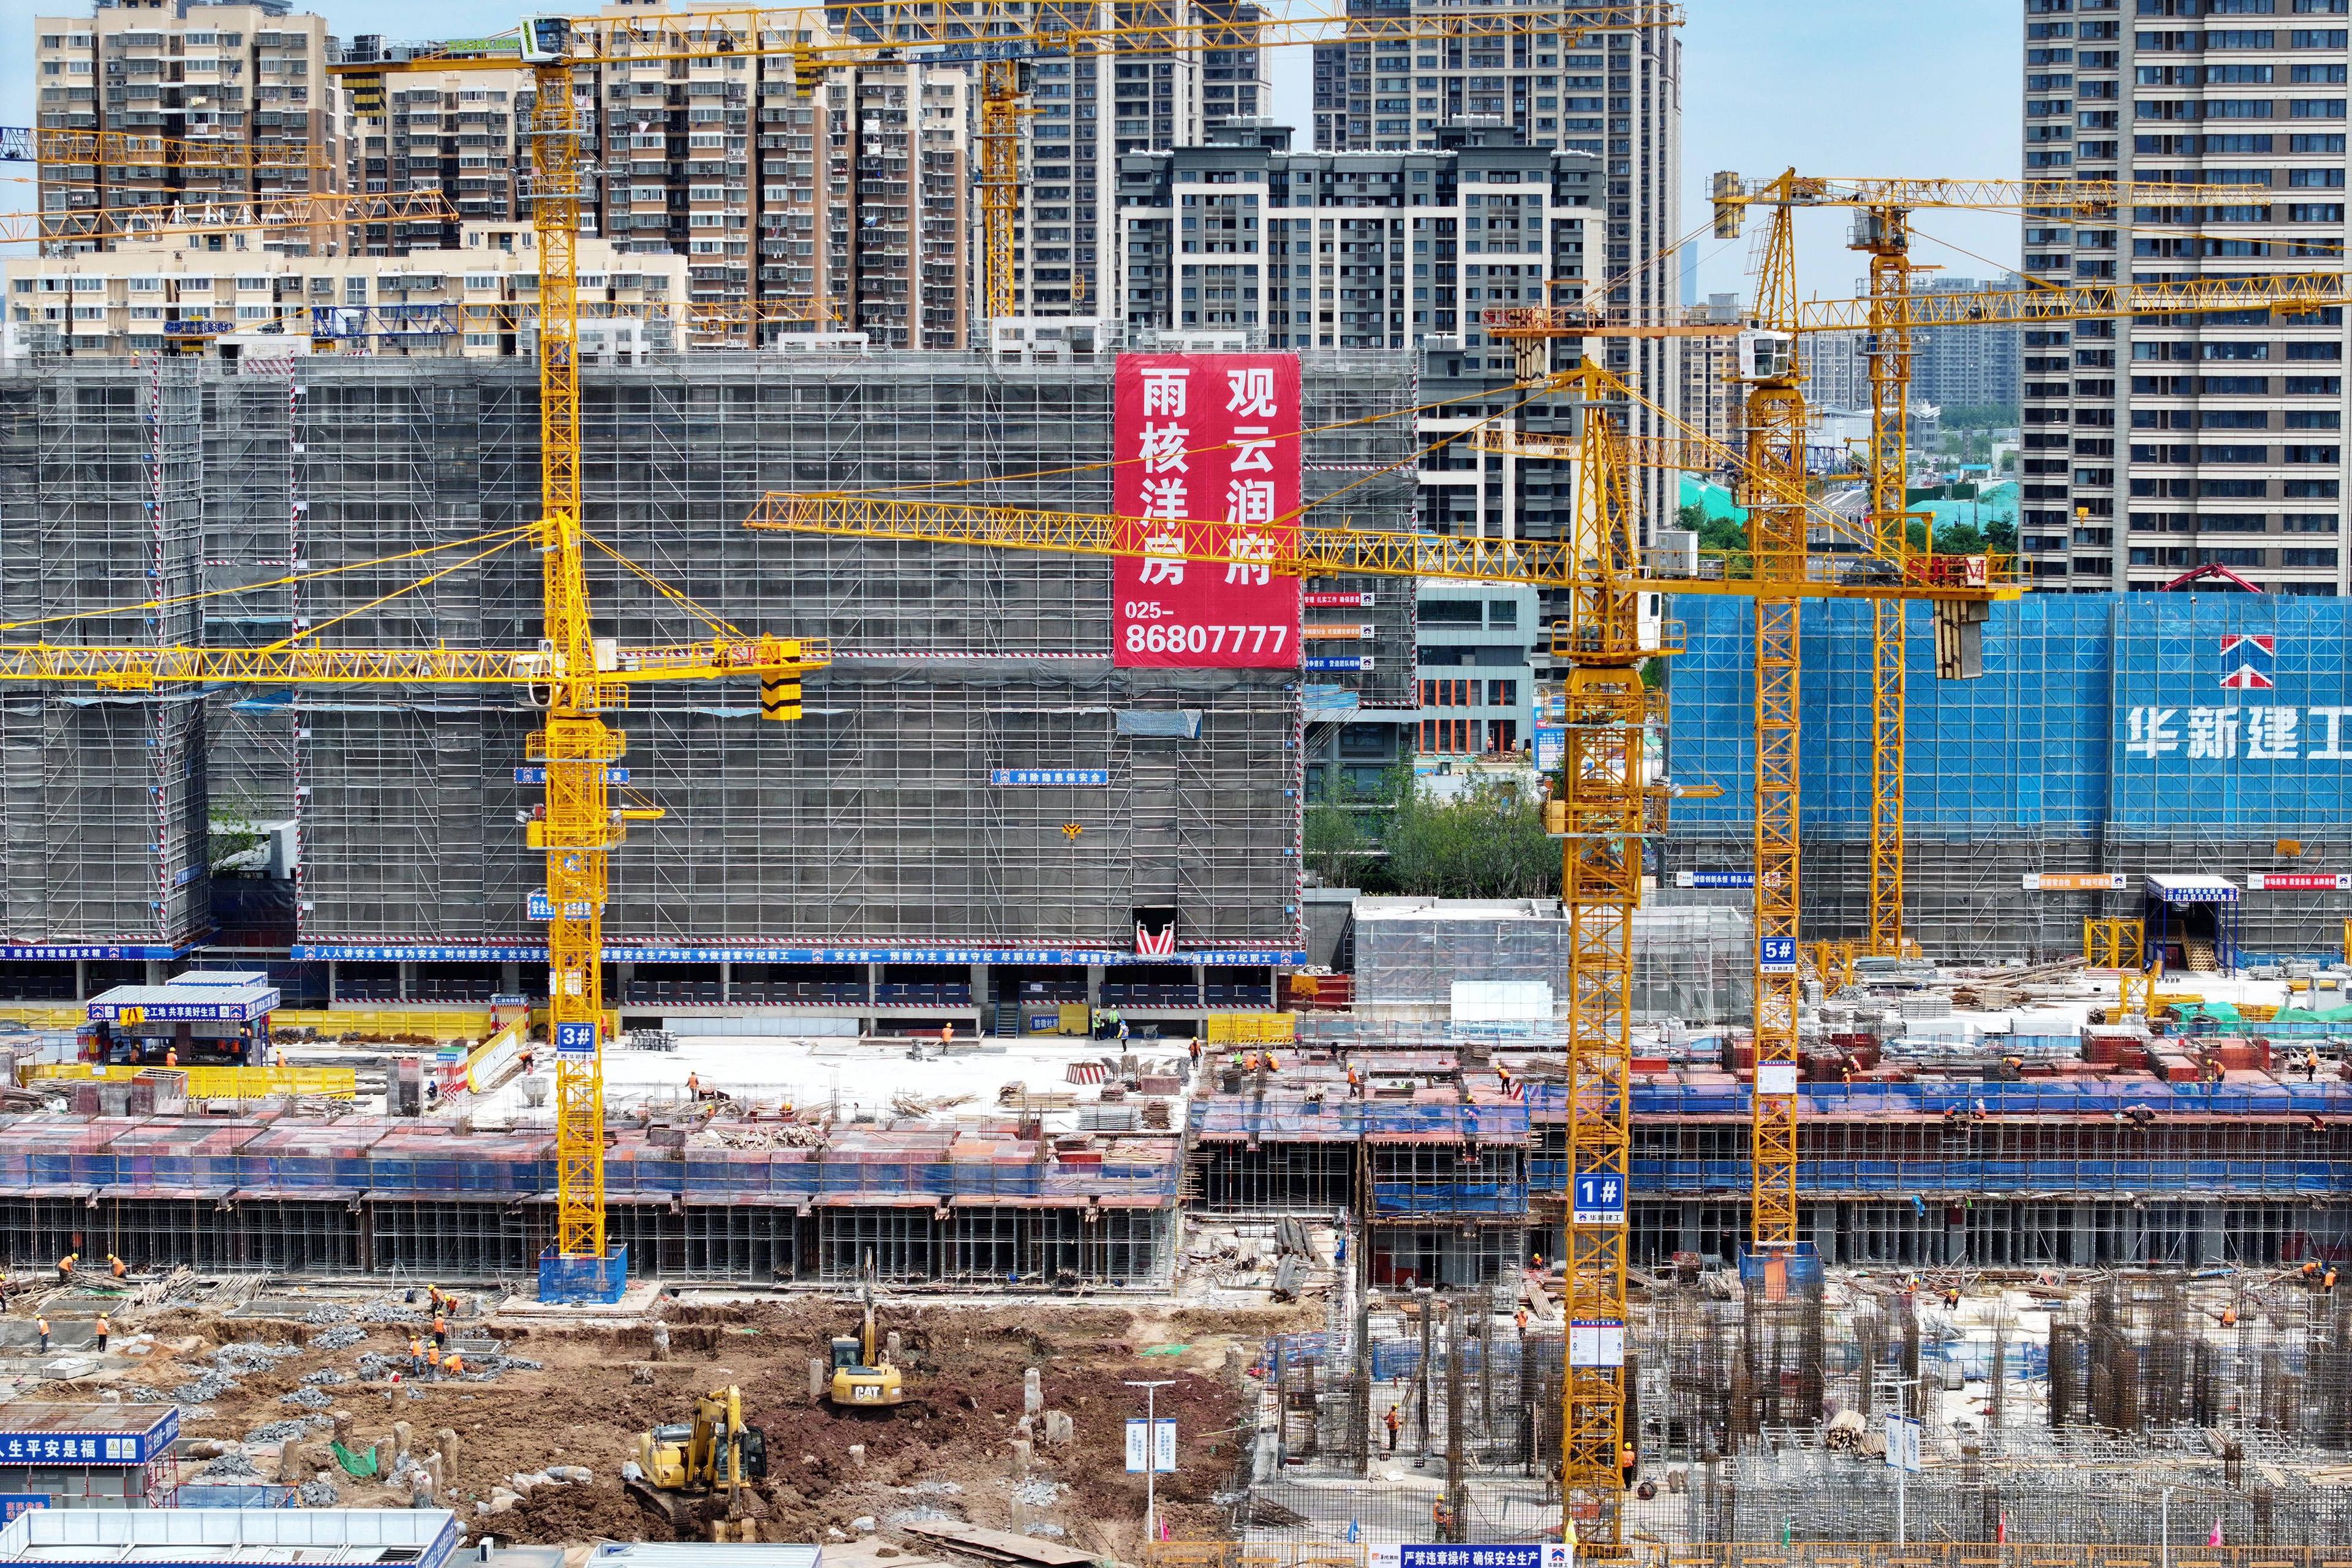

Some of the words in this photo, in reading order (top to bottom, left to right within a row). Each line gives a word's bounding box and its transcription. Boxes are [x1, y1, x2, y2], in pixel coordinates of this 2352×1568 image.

[448, 39, 519, 50] ZOOMLION
[522, 22, 534, 53] ZOOMLION
[1138, 368, 1189, 586] 雨核洋房
[1225, 368, 1277, 586] 观云润府
[1126, 625, 1287, 654] 86807777
[2127, 706, 2352, 760] 华新建工
[1018, 773, 1101, 782] 消除隐患保安全
[14, 948, 101, 958] 质量管理精益求精
[321, 948, 376, 959] 人人讲安全
[383, 949, 439, 959] 事事为安全
[445, 949, 501, 959] 时时想安全
[508, 950, 550, 960] 处处要安
[601, 951, 690, 960] 掌握安全生产知识
[698, 951, 790, 961] 争做遵章守纪职工
[835, 951, 881, 961] 安全第一
[890, 951, 937, 961] 预防为主
[945, 951, 993, 962] 遵章守纪
[1001, 952, 1048, 962] 尽职尽责
[1766, 942, 1791, 958] 5#
[1183, 953, 1272, 963] 做遵章守纪职工
[169, 1006, 216, 1017] 共享美好生活
[564, 1028, 590, 1045] 3#
[1582, 1181, 1617, 1203] 1#
[856, 1385, 880, 1401] CAT
[1404, 1551, 1469, 1566] 严禁违章操作
[1473, 1551, 1539, 1566] 确保安全生产
